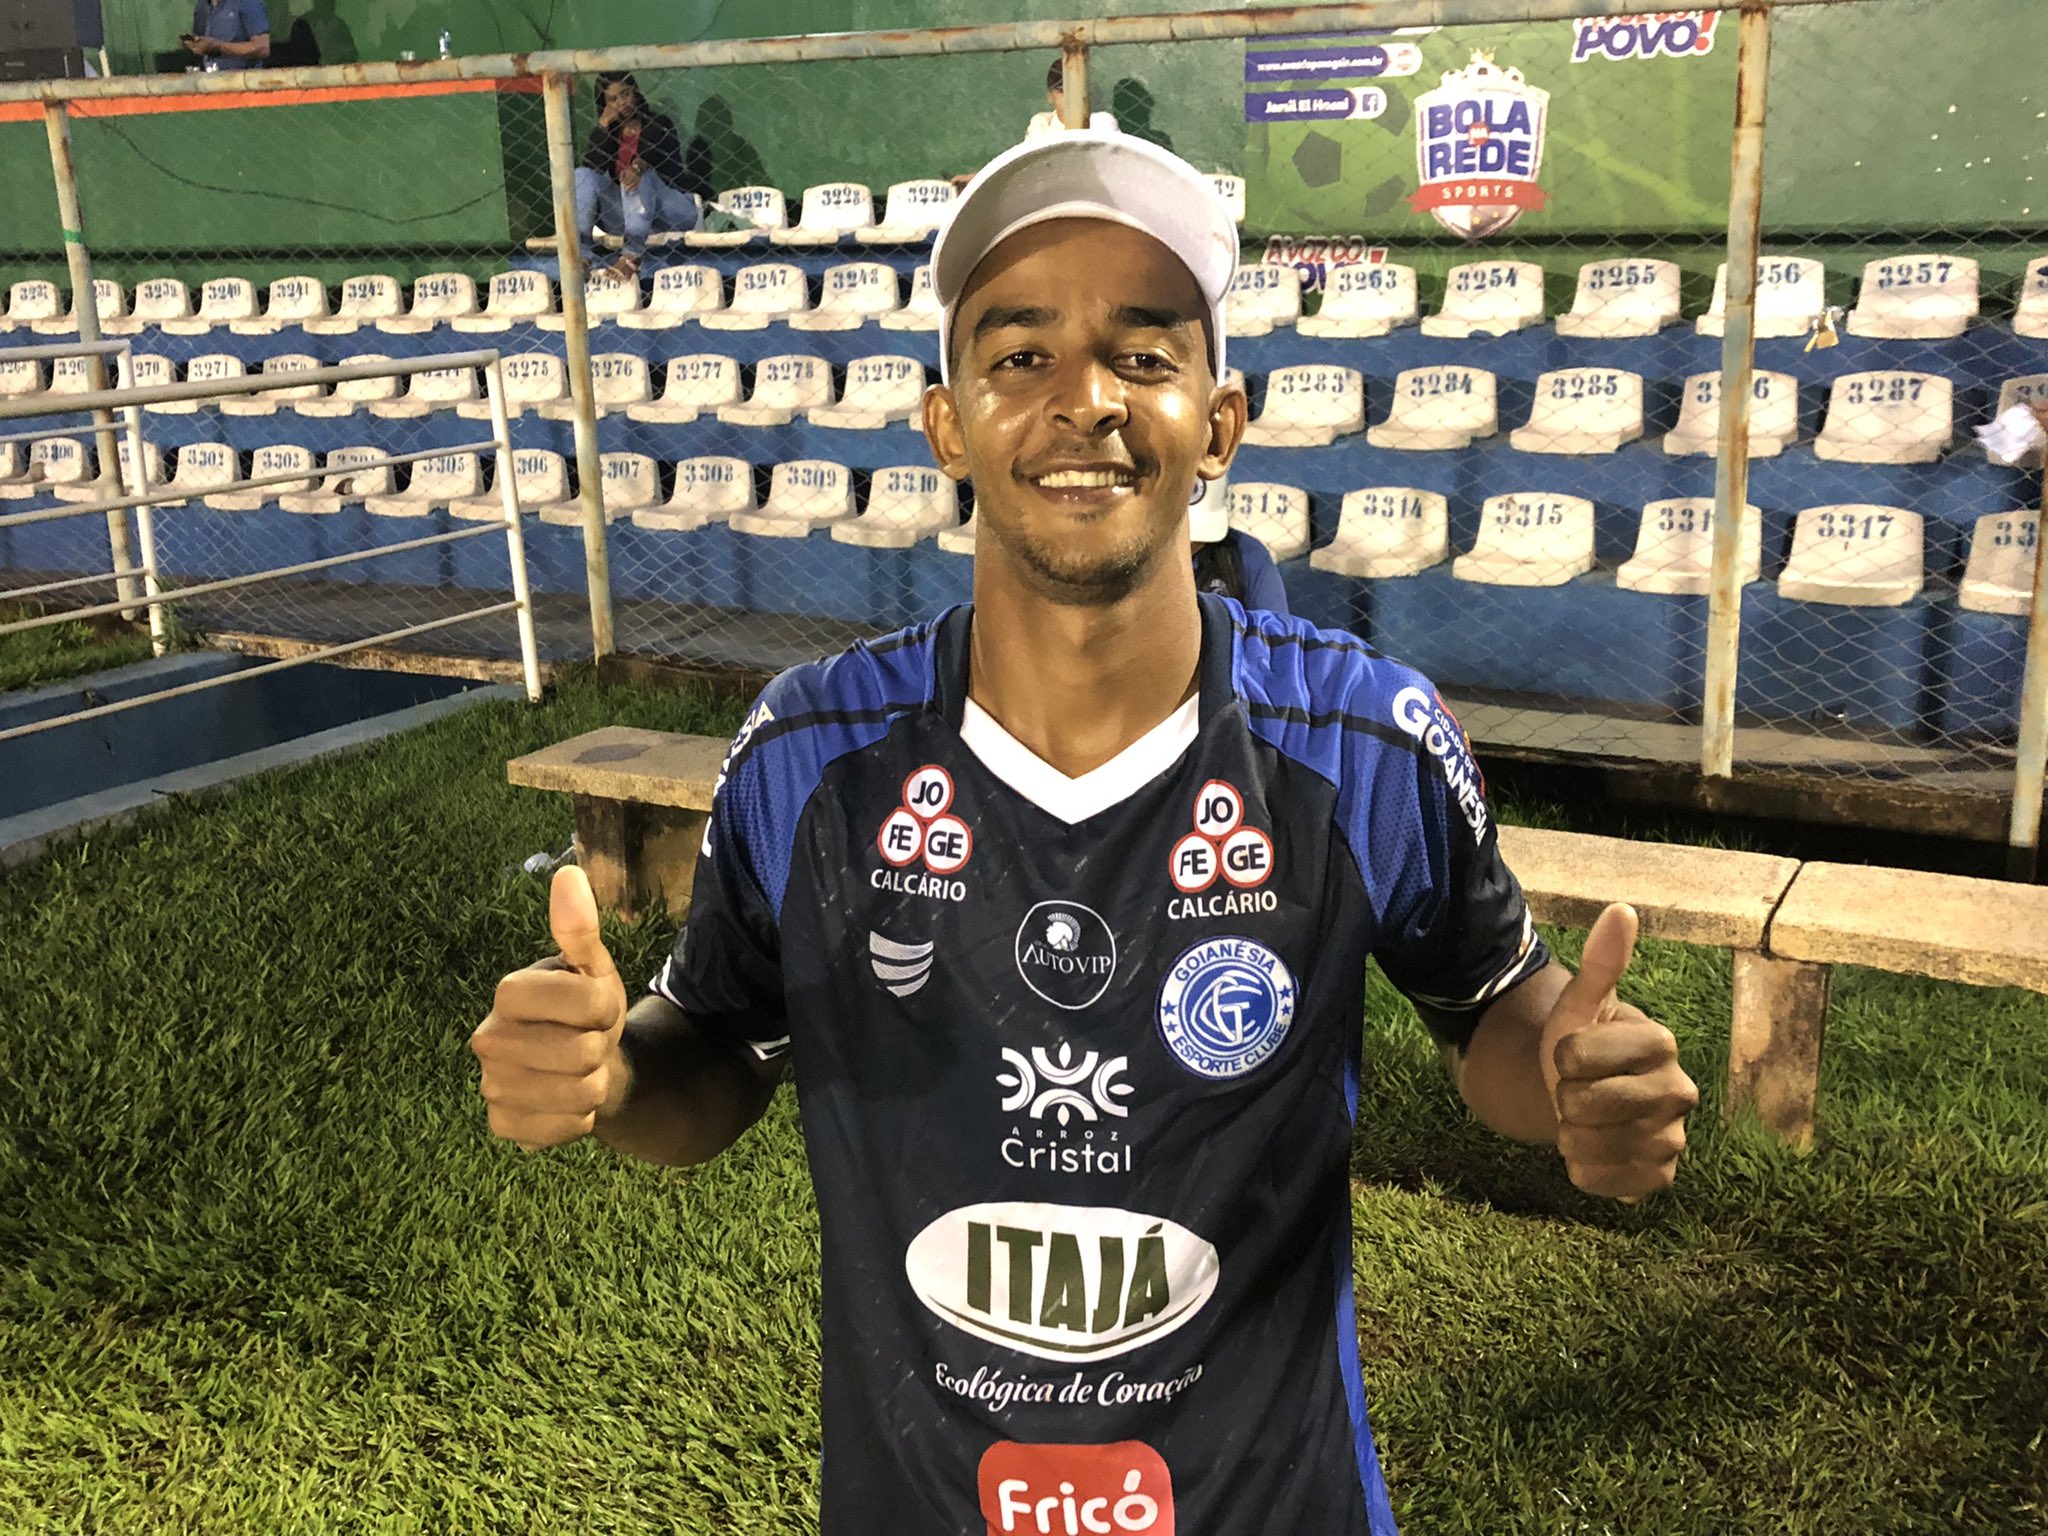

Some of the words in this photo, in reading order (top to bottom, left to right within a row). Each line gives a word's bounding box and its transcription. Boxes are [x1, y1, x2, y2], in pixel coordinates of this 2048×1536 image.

[1428, 99, 1531, 139] BOLA
[1428, 138, 1532, 180] REDE
[1441, 185, 1514, 200] SPORTS
[743, 269, 788, 290] 3247
[1456, 266, 1519, 293] 3254
[1590, 265, 1657, 291] 3255
[1756, 262, 1802, 286] 256
[1877, 261, 1954, 289] 3257
[58, 359, 86, 376] 326
[134, 361, 160, 378] 270
[508, 360, 550, 379] 3275
[591, 359, 634, 378] 3276
[676, 361, 723, 381] 3277
[766, 361, 815, 381] 3278
[857, 362, 908, 383] 3279
[1281, 369, 1346, 395] 3283
[1410, 371, 1474, 398] 3284
[1551, 373, 1619, 400] 3285
[1696, 376, 1770, 404] 36
[1848, 377, 1926, 405] 3287
[516, 455, 549, 475] 306
[684, 463, 734, 486] 3308
[786, 466, 837, 489] 3309
[887, 471, 939, 495] 3310
[1362, 493, 1423, 520] 3314
[1495, 501, 1564, 528] 3315
[1658, 506, 1714, 533] 331
[1818, 512, 1895, 540] 3317
[1994, 519, 2038, 548] 33
[911, 780, 945, 807] JO
[1199, 796, 1234, 825] JO
[887, 823, 914, 851] FE
[927, 830, 964, 860] GE
[1179, 848, 1209, 877] FE
[1226, 842, 1266, 872] GE
[870, 867, 967, 902] CALCÁRIO
[1167, 889, 1278, 920] CALCÁRIO
[1174, 940, 1277, 982] GOIANÉSIA
[1172, 1035, 1242, 1073] ESPORTE
[1243, 1021, 1290, 1066] CLUBE
[1011, 1125, 1119, 1142] ARROZ
[1000, 1137, 1132, 1174] Cristal
[966, 1220, 1171, 1335] ITAJÁ
[935, 1362, 1055, 1412] Ecológica
[1057, 1371, 1094, 1404] de
[1096, 1362, 1204, 1406] Coração
[998, 1468, 1159, 1536] Fricó
